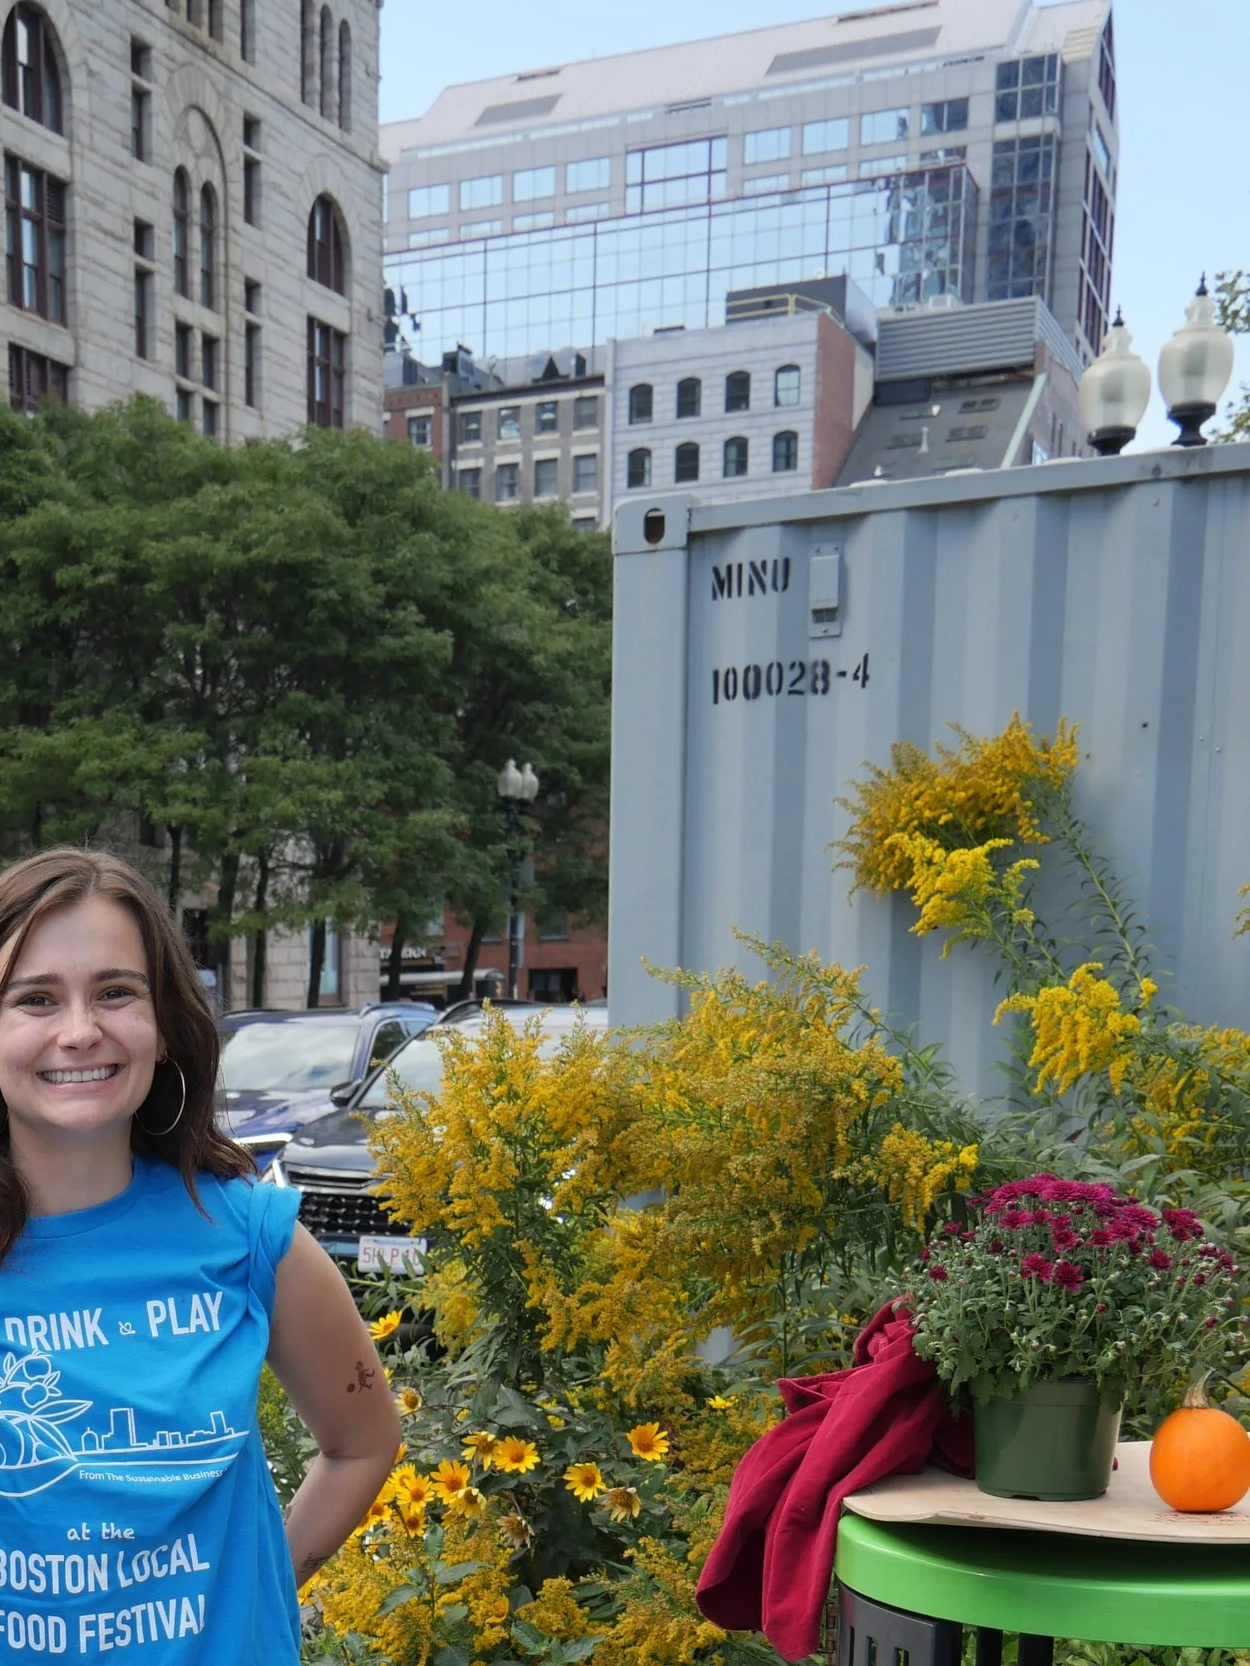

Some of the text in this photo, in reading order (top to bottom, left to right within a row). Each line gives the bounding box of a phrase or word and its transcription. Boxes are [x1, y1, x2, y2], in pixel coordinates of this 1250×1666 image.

[711, 556, 791, 601] MINU
[712, 653, 871, 705] 100028-4
[4, 1308, 109, 1351] DRINK
[145, 1291, 224, 1338] PLAY
[79, 1469, 224, 1483] From The Sustainable Business
[67, 1521, 135, 1542] at the
[118, 1533, 210, 1588] LOCAL
[78, 1594, 206, 1654] FESTIVAL
